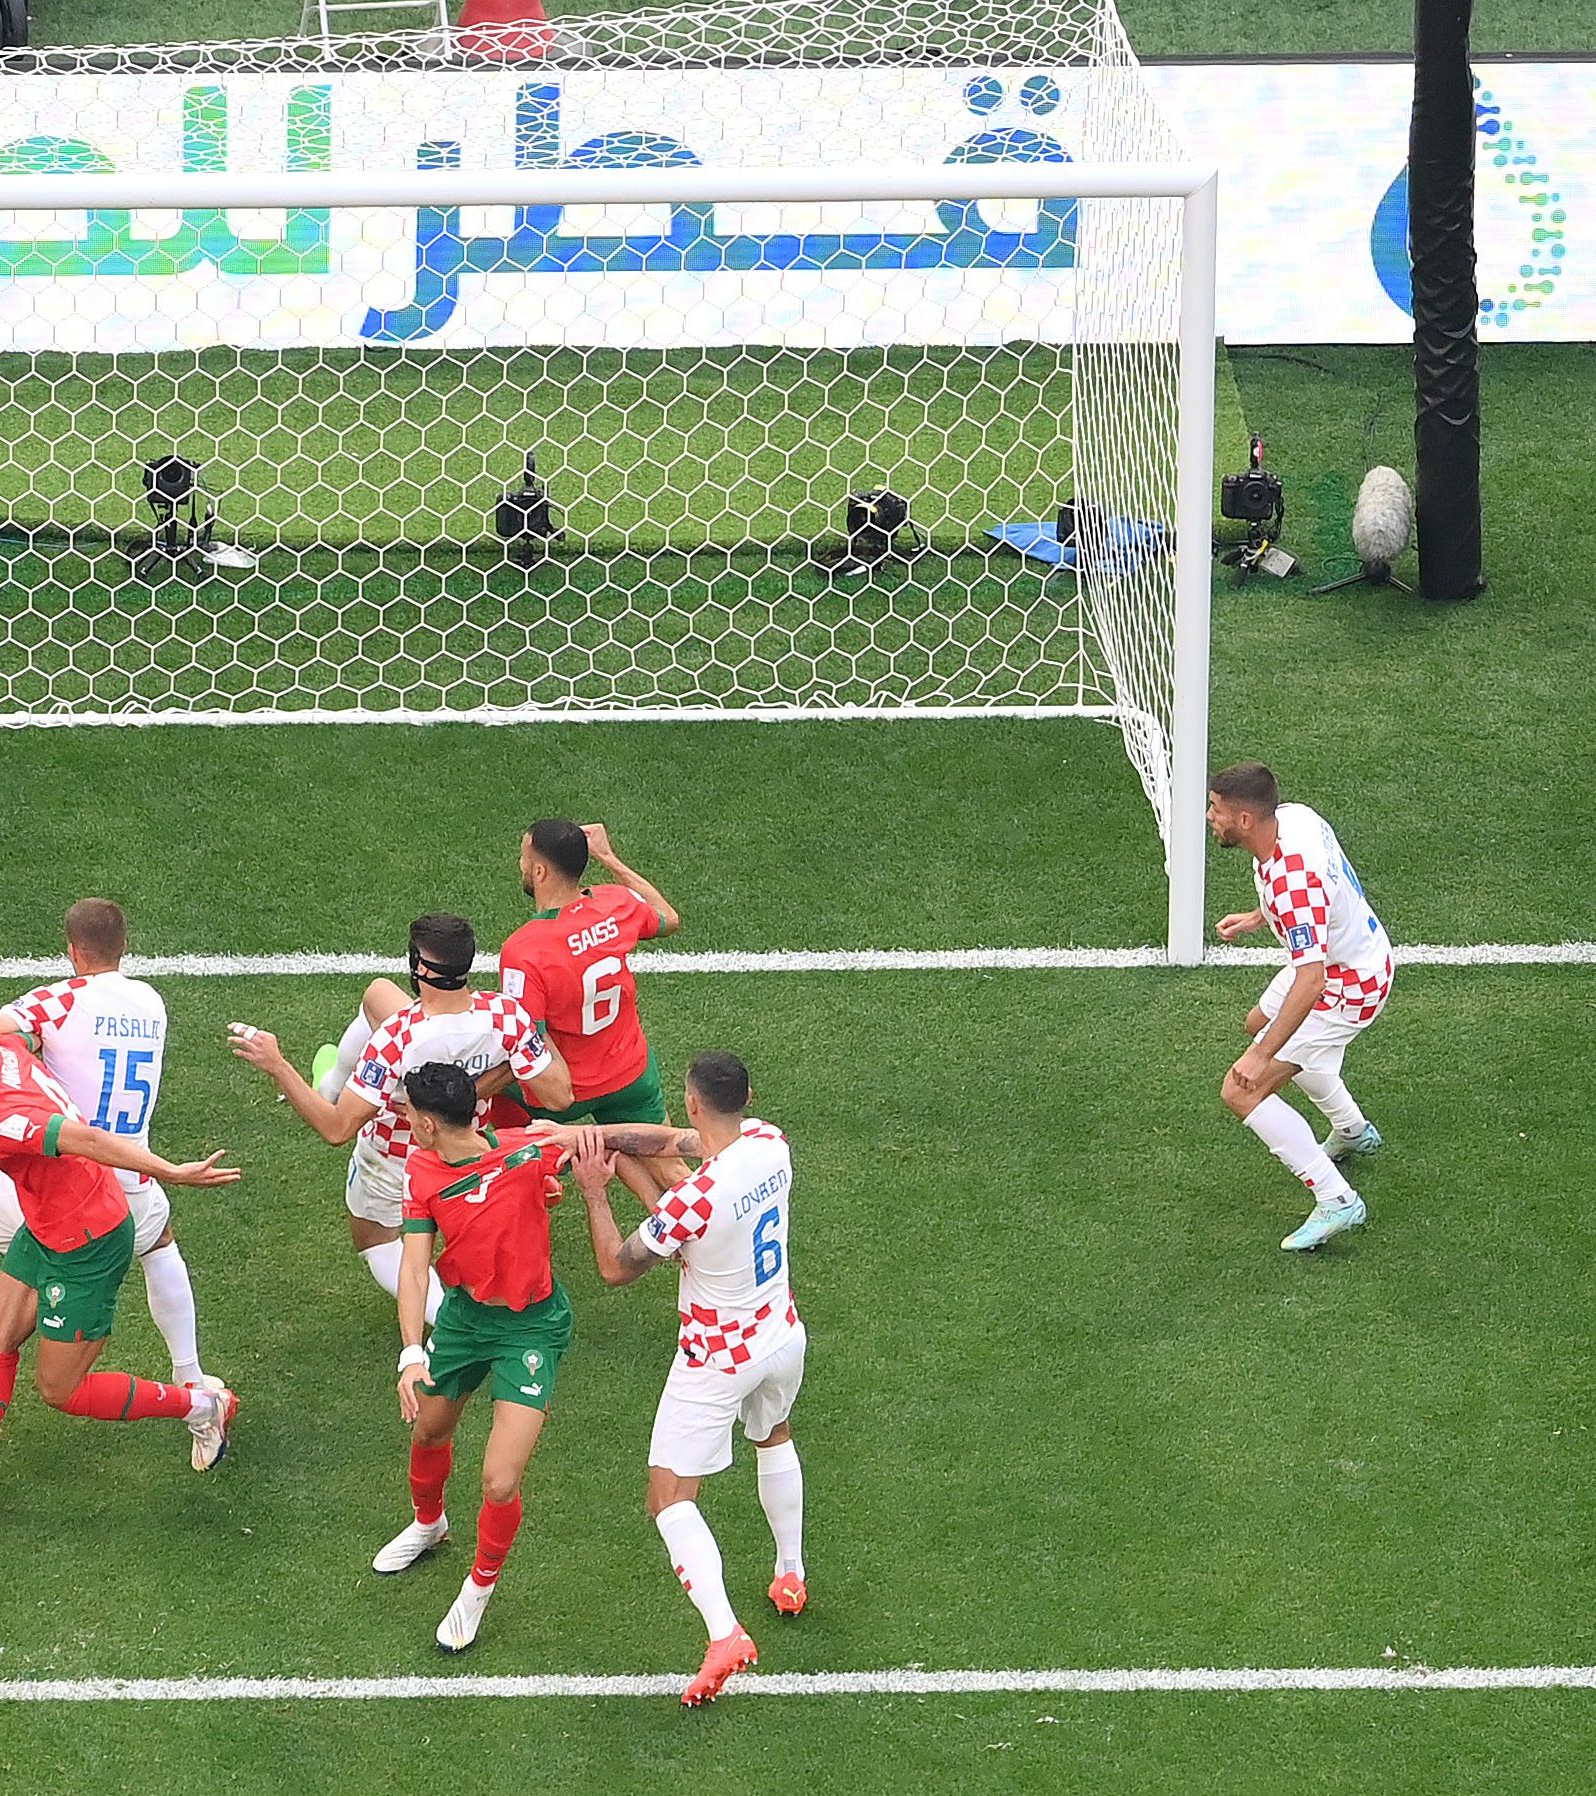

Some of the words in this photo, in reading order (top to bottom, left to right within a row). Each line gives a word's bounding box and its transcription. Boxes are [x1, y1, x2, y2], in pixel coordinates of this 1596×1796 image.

[359, 75, 1079, 342] قطر
[567, 916, 619, 956] SAISS
[582, 955, 622, 1036] 6
[89, 1048, 154, 1134] 15
[733, 1168, 788, 1222] LOVREN
[752, 1205, 782, 1288] 6
